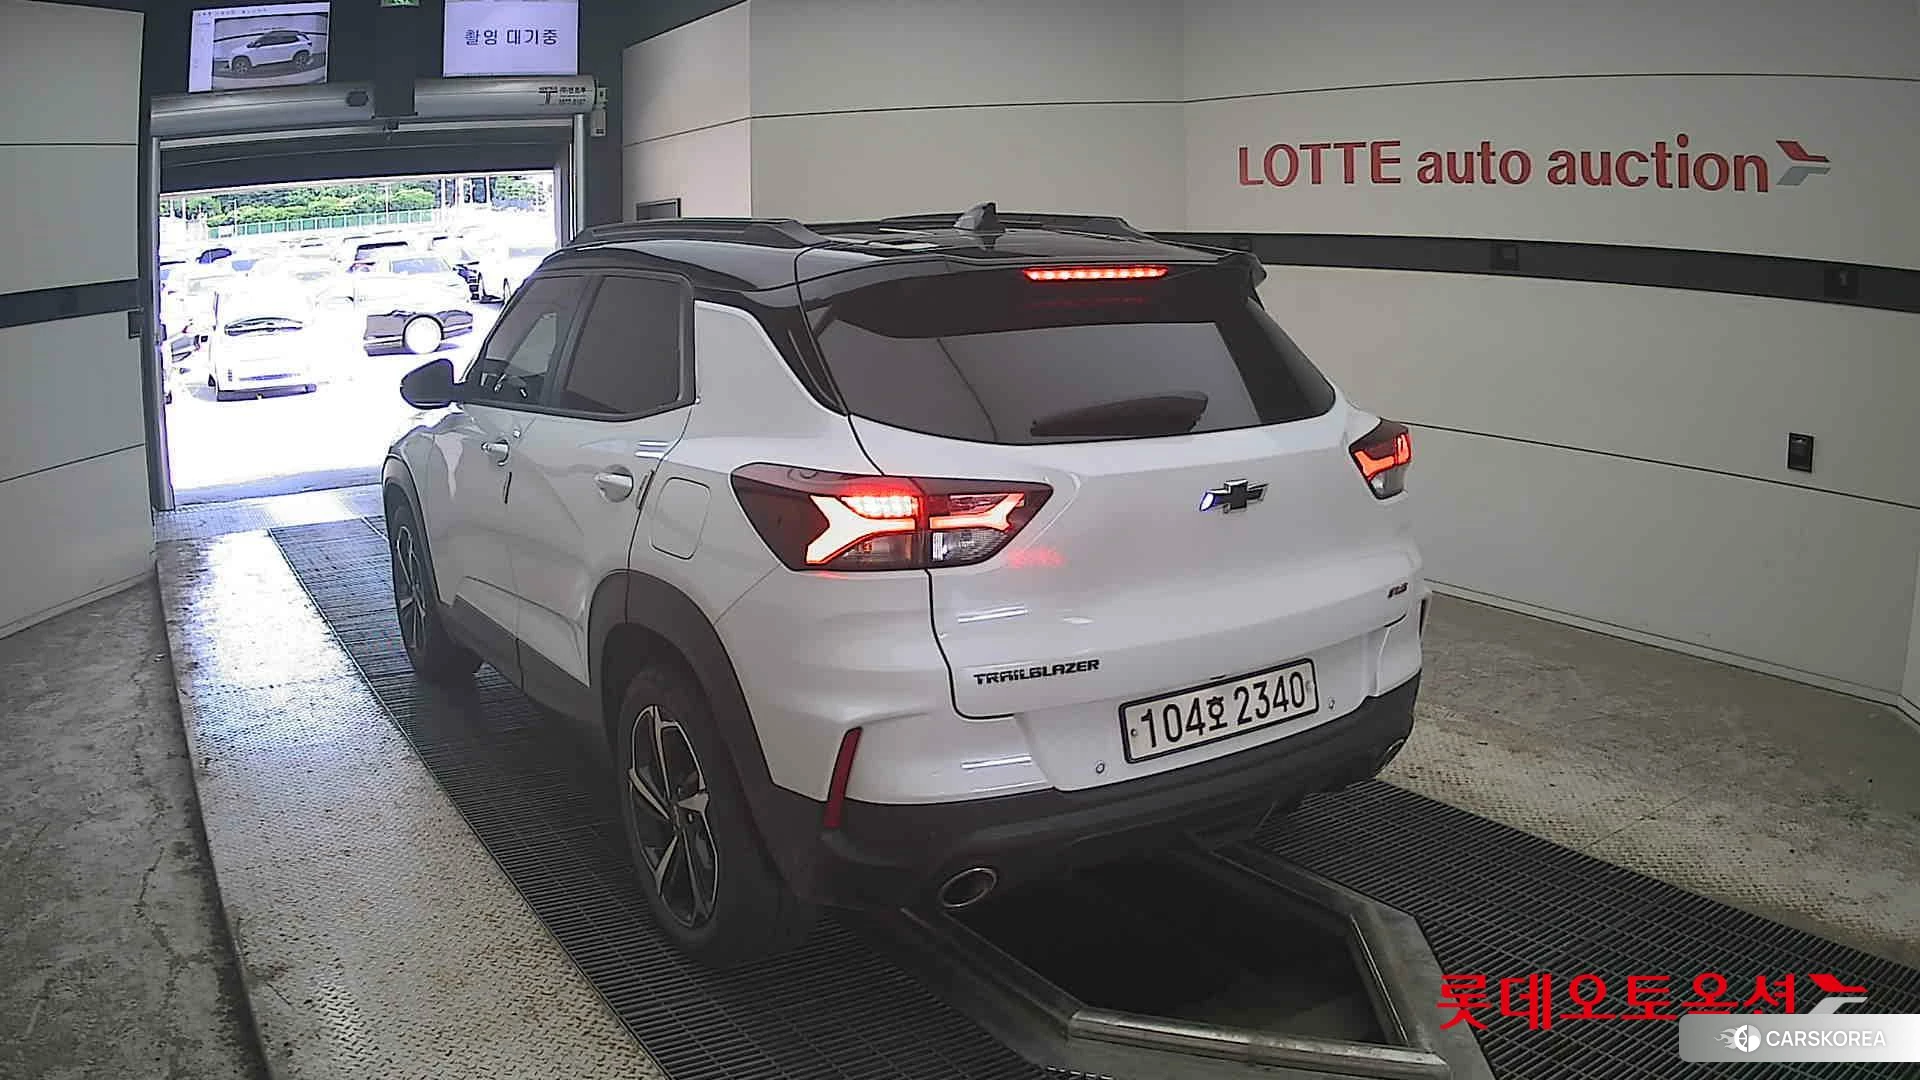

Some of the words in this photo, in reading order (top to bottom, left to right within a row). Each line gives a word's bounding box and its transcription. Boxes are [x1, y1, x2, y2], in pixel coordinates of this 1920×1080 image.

[506, 29, 558, 45] 대기중
[1239, 141, 1401, 188] LOTTE
[1417, 142, 1532, 185] auto
[1548, 134, 1769, 193] auction
[973, 659, 1100, 685] TRAILBLAZER
[1140, 695, 1228, 748] 104호
[1233, 670, 1306, 727] 2340
